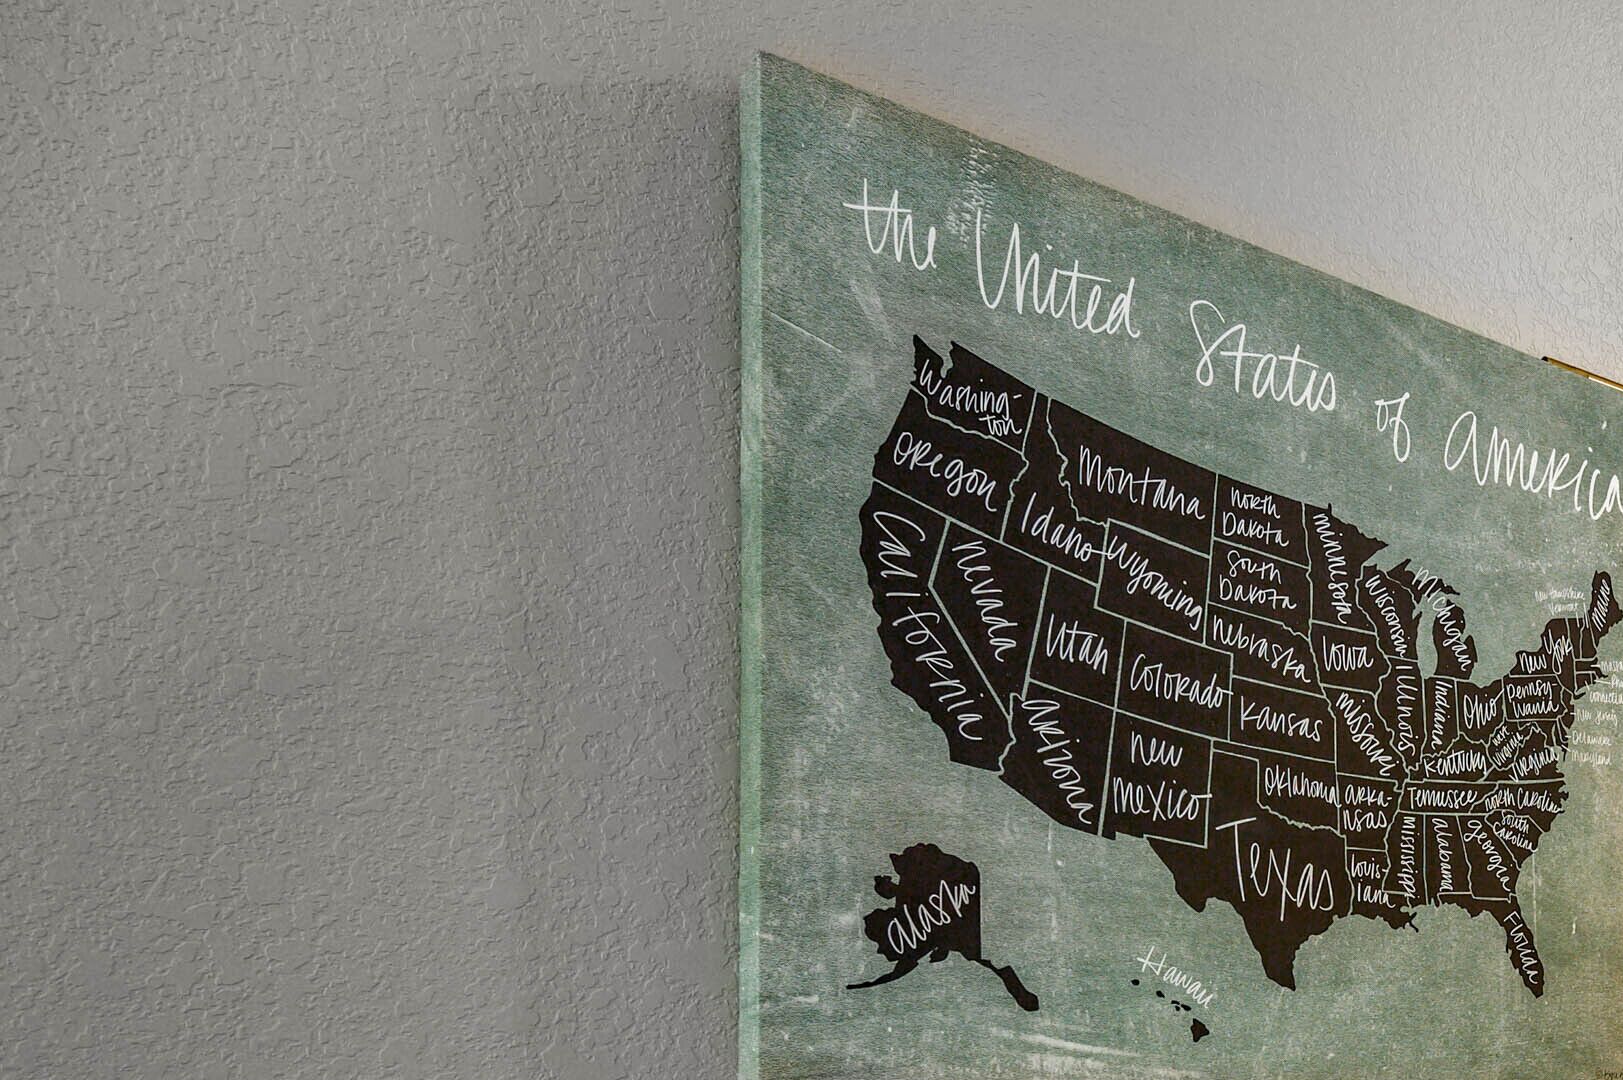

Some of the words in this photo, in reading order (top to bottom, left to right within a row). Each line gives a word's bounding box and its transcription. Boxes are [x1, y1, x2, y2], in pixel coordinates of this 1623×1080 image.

[842, 177, 937, 270] the
[975, 207, 1141, 338] United
[1189, 300, 1337, 412] States
[1374, 391, 1411, 463] of
[893, 431, 998, 512] Oregon
[1020, 491, 1096, 562] Idaho
[1222, 511, 1290, 547] Dakota
[1219, 574, 1297, 610] Dakota
[872, 510, 984, 741] California
[1045, 612, 1110, 675] Utah
[1212, 614, 1312, 684] Nebraska
[1322, 635, 1375, 672] Iowa
[1129, 652, 1233, 709] Colorado
[1240, 695, 1324, 742] Kansas
[1264, 763, 1342, 808] Oklahoma
[1423, 749, 1487, 778] Kentucky
[1215, 816, 1335, 923] Texas
[1503, 909, 1540, 986] Florida
